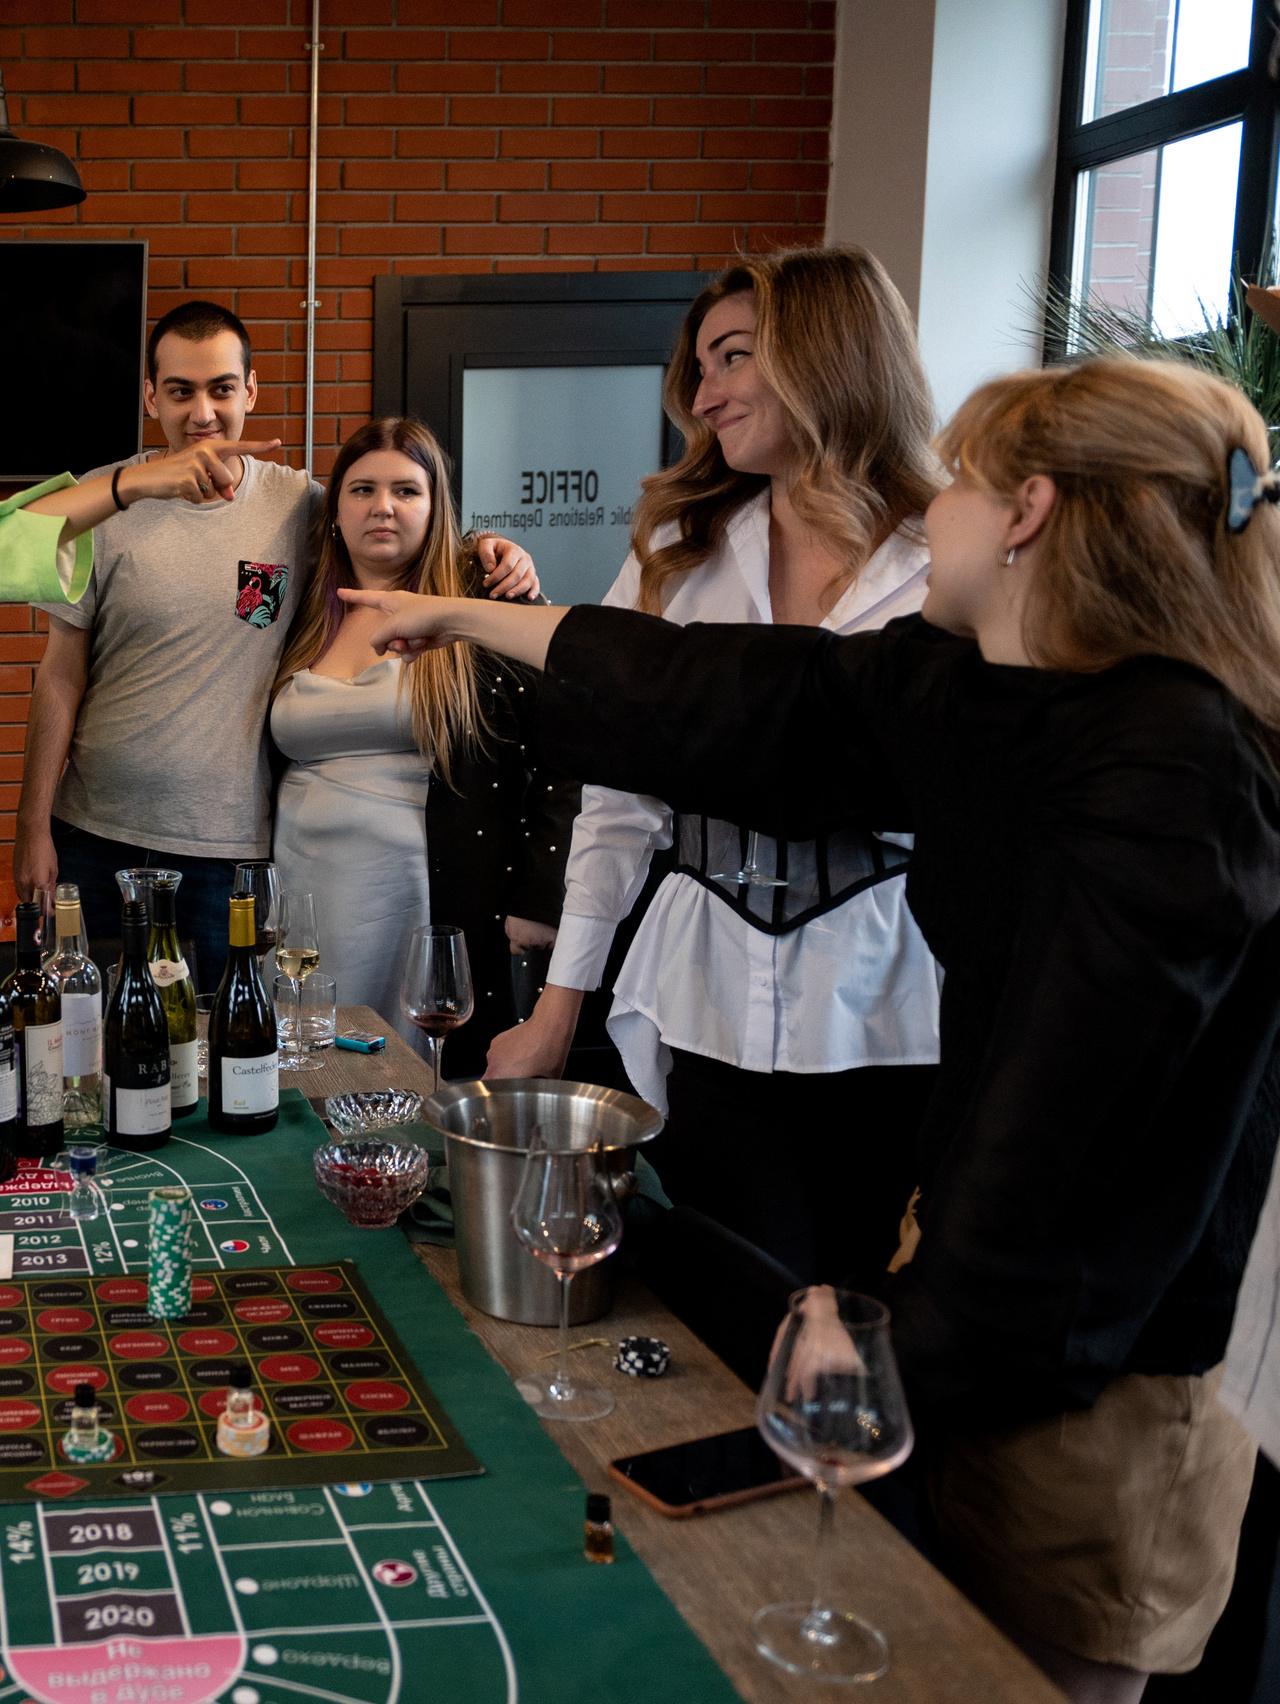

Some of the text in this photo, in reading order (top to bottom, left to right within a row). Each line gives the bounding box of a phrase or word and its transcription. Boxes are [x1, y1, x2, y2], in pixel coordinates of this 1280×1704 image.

[11, 1197, 50, 1207] 2010
[14, 1215, 53, 1226] 2011
[18, 1235, 62, 1246] 2012
[21, 1254, 68, 1266] 2013
[93, 1241, 114, 1264] 12%
[6, 1520, 35, 1564] 14%
[69, 1523, 134, 1544] 2018
[170, 1512, 204, 1554] 11%
[77, 1562, 140, 1585] 2019
[84, 1604, 155, 1631] 2020
[106, 1643, 143, 1661] Не
[48, 1662, 211, 1687] выдержано
